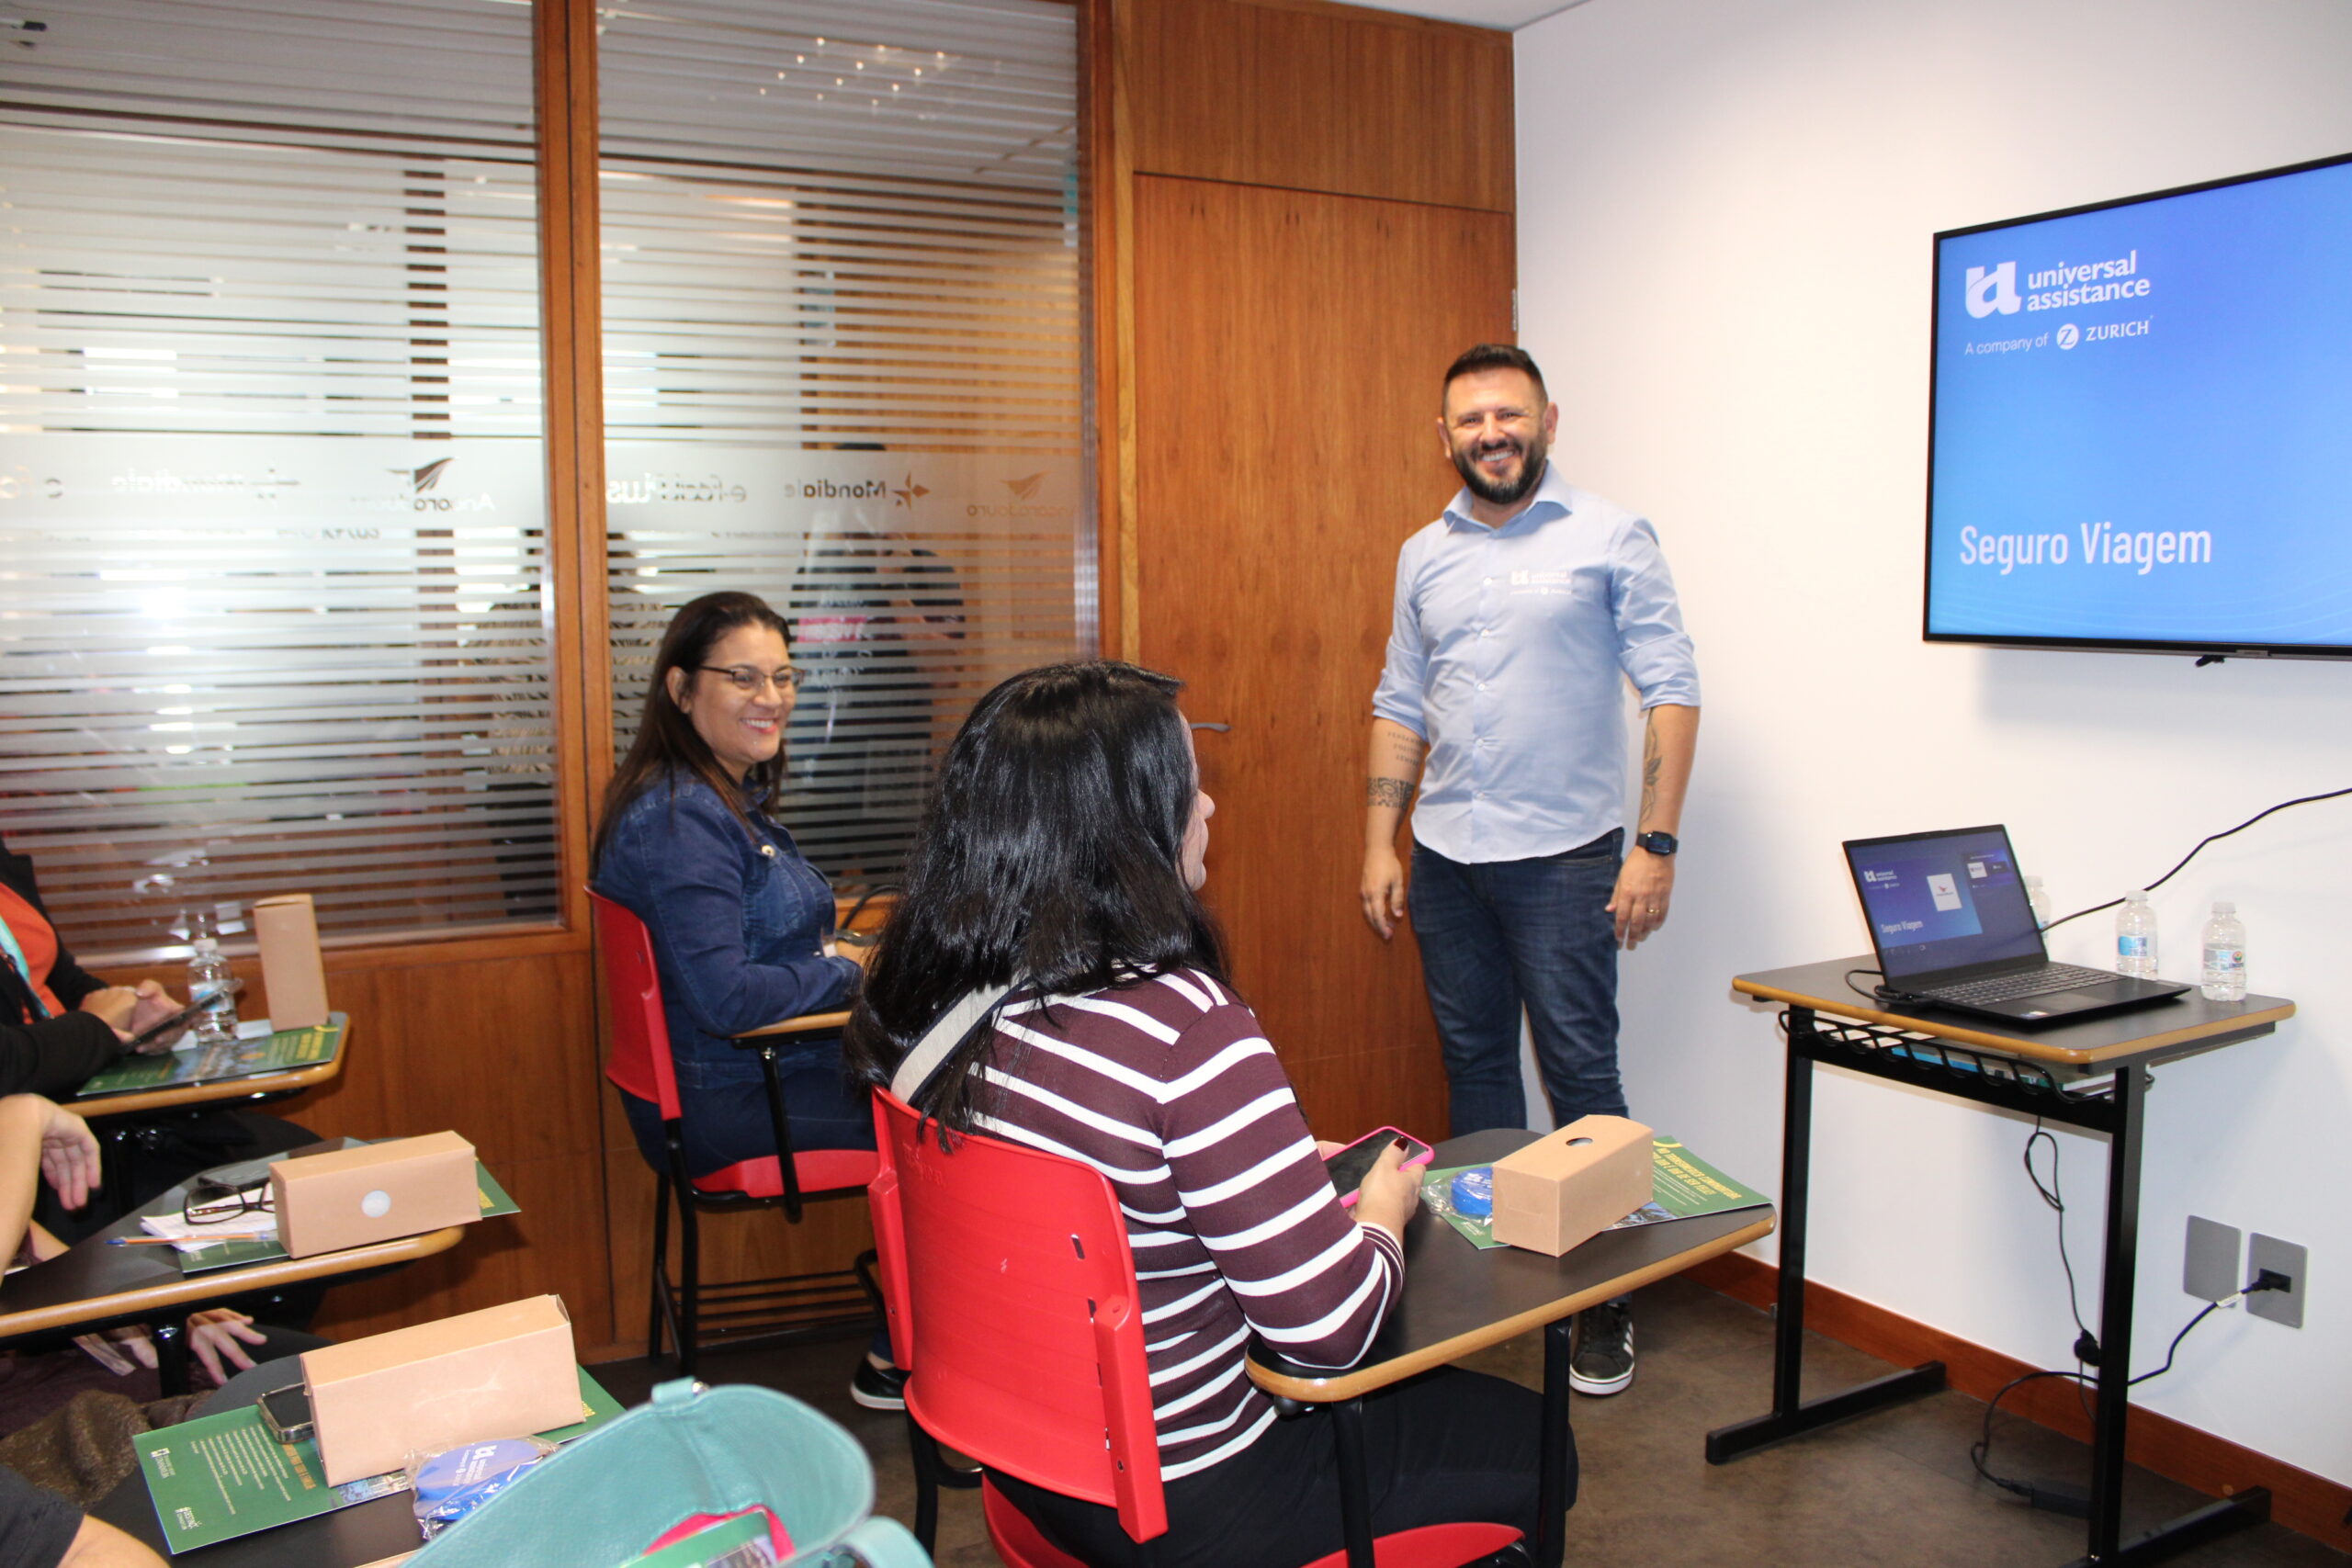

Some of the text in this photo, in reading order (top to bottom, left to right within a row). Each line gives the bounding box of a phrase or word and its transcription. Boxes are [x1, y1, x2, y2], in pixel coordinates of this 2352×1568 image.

[2028, 250, 2137, 290] universal
[2027, 278, 2151, 312] assistance
[1964, 342, 1974, 355] A
[1976, 337, 2033, 355] company
[2035, 332, 2050, 347] of
[2086, 320, 2150, 342] ZURICH
[1960, 521, 2212, 576] Seguro Viagem
